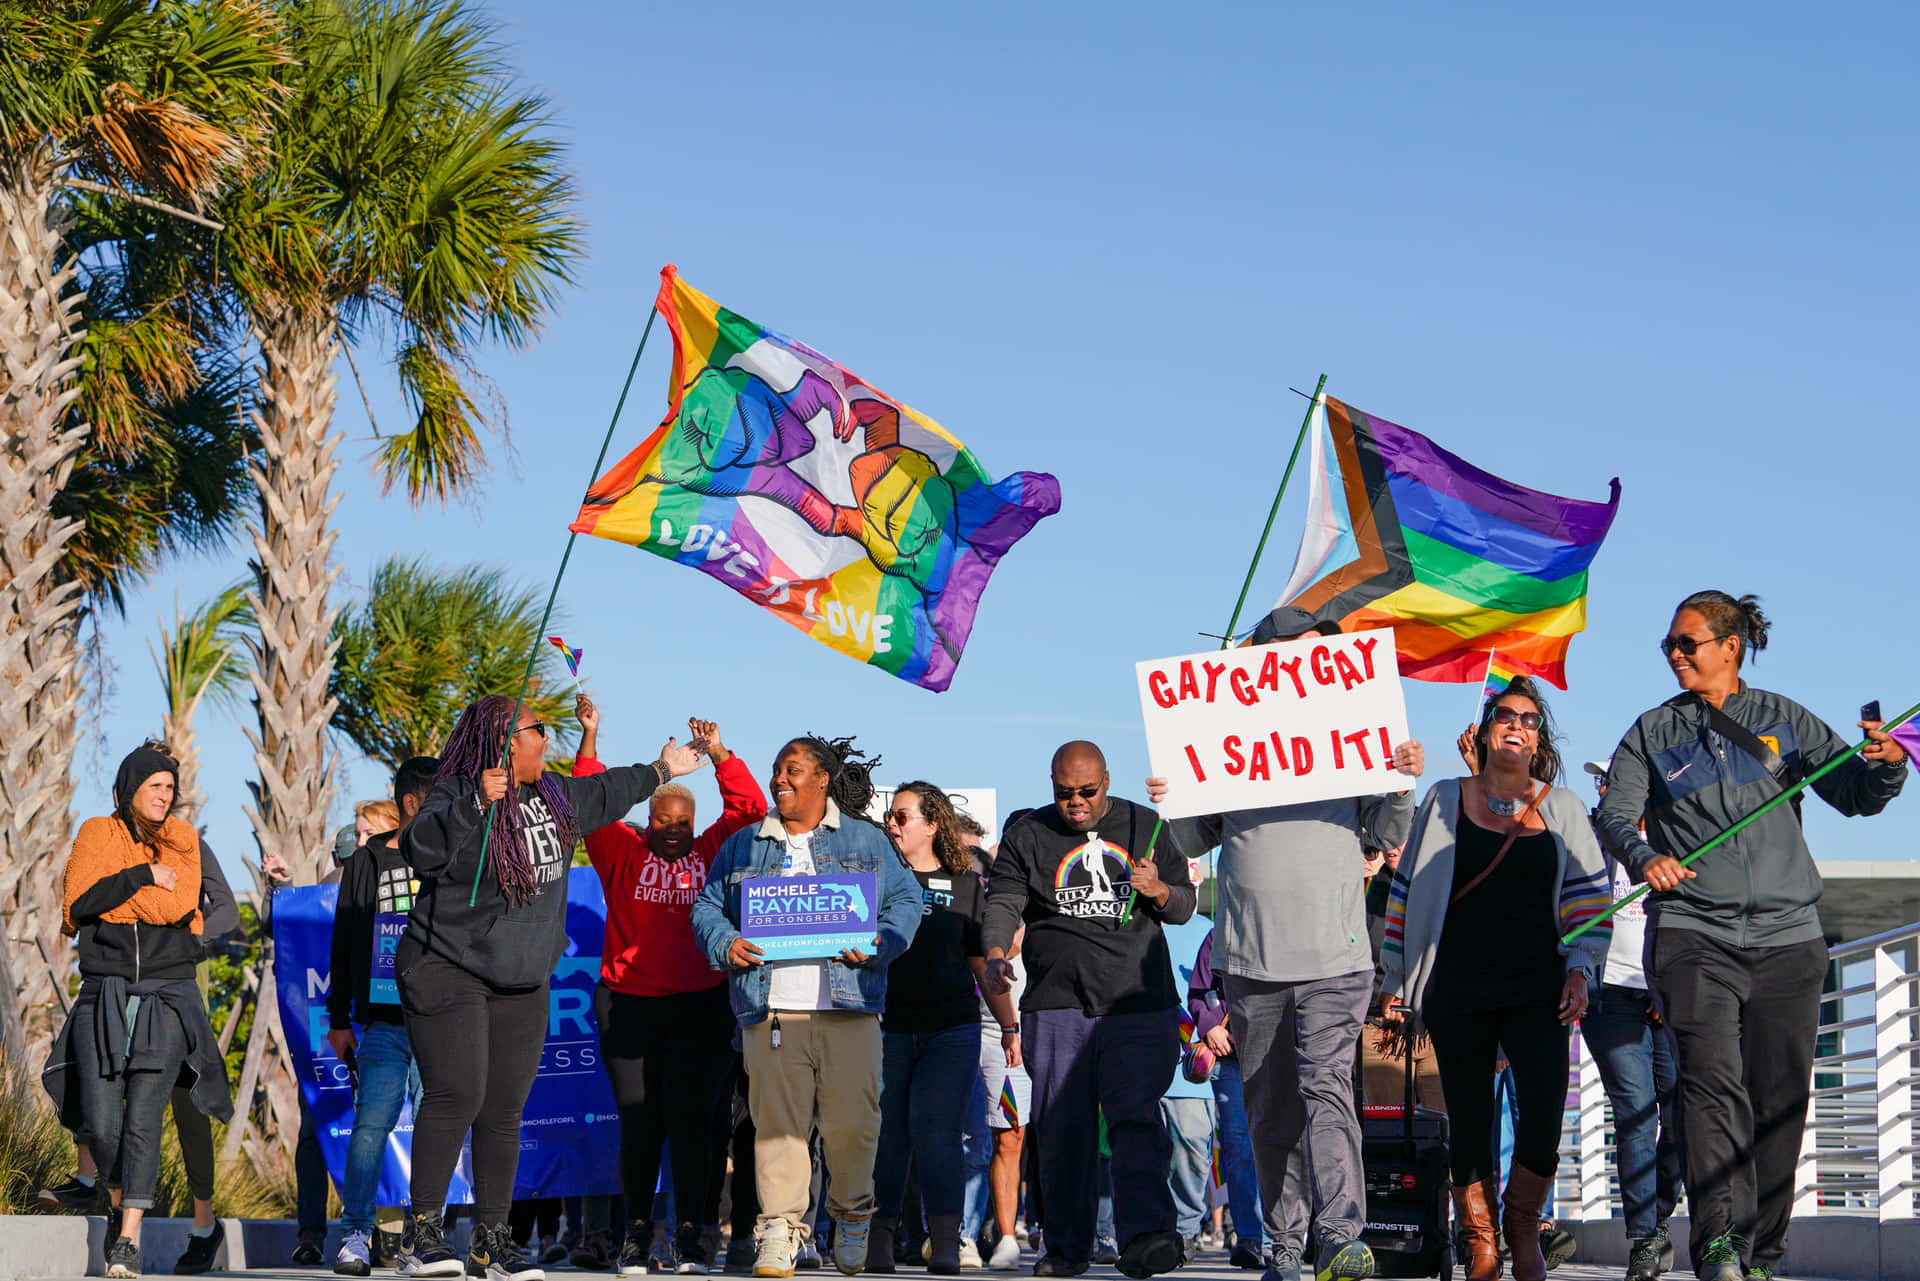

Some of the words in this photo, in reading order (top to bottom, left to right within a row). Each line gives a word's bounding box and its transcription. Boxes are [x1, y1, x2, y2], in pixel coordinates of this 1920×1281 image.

[802, 587, 894, 653] LOVE
[1184, 744, 1207, 782] I
[1223, 731, 1314, 781] SAID
[1330, 726, 1396, 771] IT!
[640, 862, 706, 889] OVER
[634, 886, 701, 905] EVERYTHIN
[748, 884, 818, 897] MICHELE
[1055, 888, 1089, 902] CITY
[748, 895, 847, 914] RAYNER
[748, 917, 772, 925] FOR
[778, 913, 847, 924] CONGRESS
[1364, 1222, 1419, 1232] MONSTER
